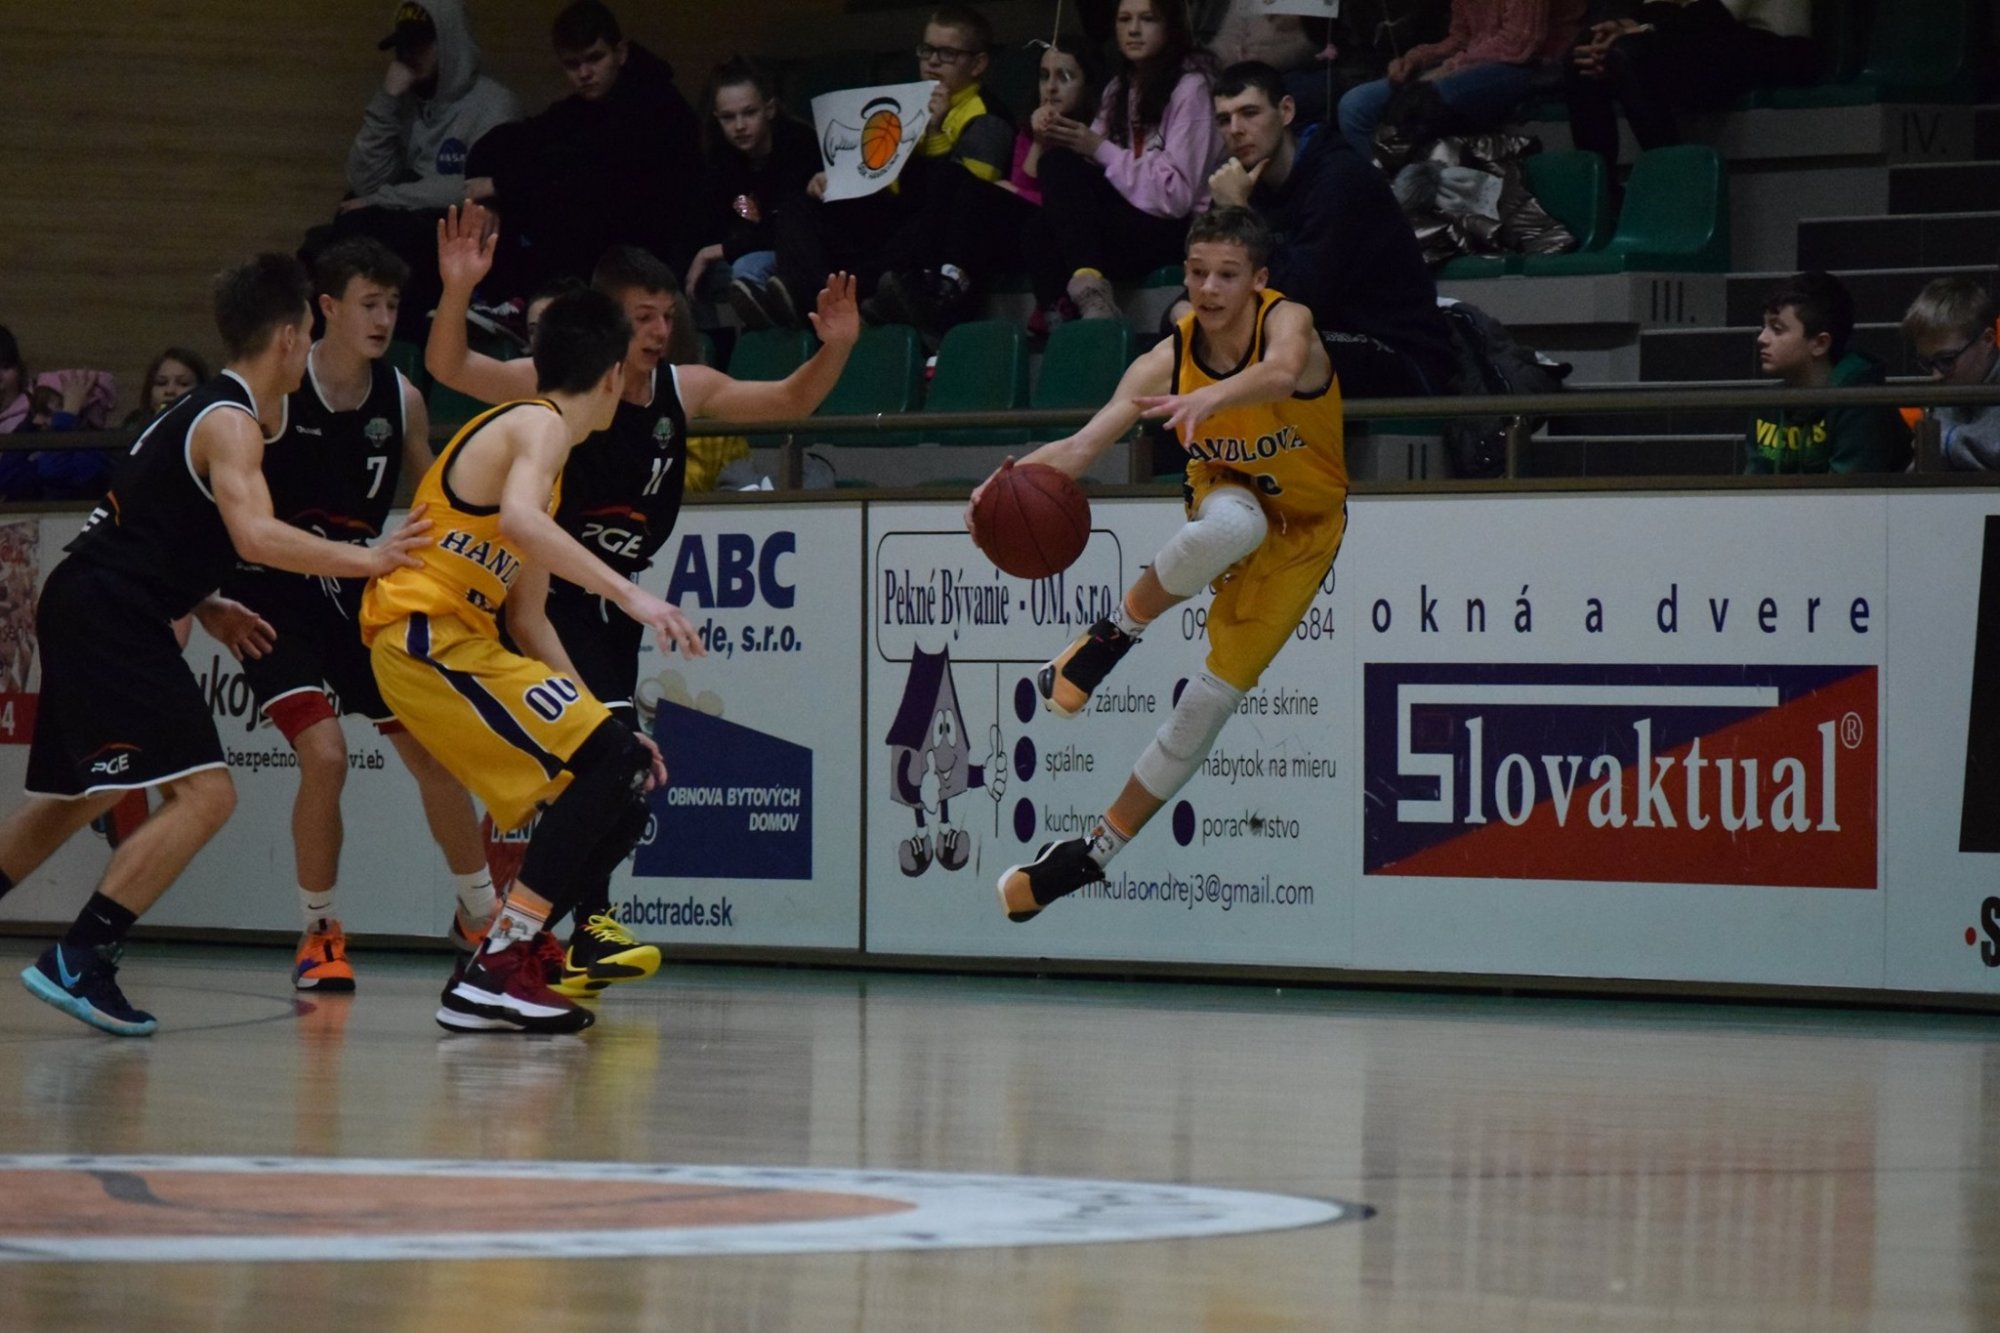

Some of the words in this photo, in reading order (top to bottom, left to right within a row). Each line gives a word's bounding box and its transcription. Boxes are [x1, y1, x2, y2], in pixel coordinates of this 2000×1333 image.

[366, 455, 388, 499] 7
[642, 457, 674, 497] 11
[666, 531, 796, 609] ABC
[884, 568, 936, 625] Pekné
[940, 568, 1009, 641] Bývanie
[1371, 584, 1533, 634] okná
[1584, 597, 1604, 634] a
[1656, 583, 1872, 635] dvere
[741, 625, 802, 652] s.r.o.
[1095, 685, 1157, 713] zárubne
[1273, 687, 1319, 716] skrine
[228, 747, 298, 772] bezpečno
[1046, 744, 1095, 781] spálne
[1202, 750, 1265, 785] nábytok
[1269, 757, 1288, 778] na
[1293, 752, 1337, 778] mieru
[1397, 683, 1842, 834] Slovaktual
[667, 786, 724, 806] OBNOVA
[726, 783, 801, 807] BYTOVÝCH
[749, 812, 800, 832] DOMOV
[1202, 809, 1300, 847] poradnstvo
